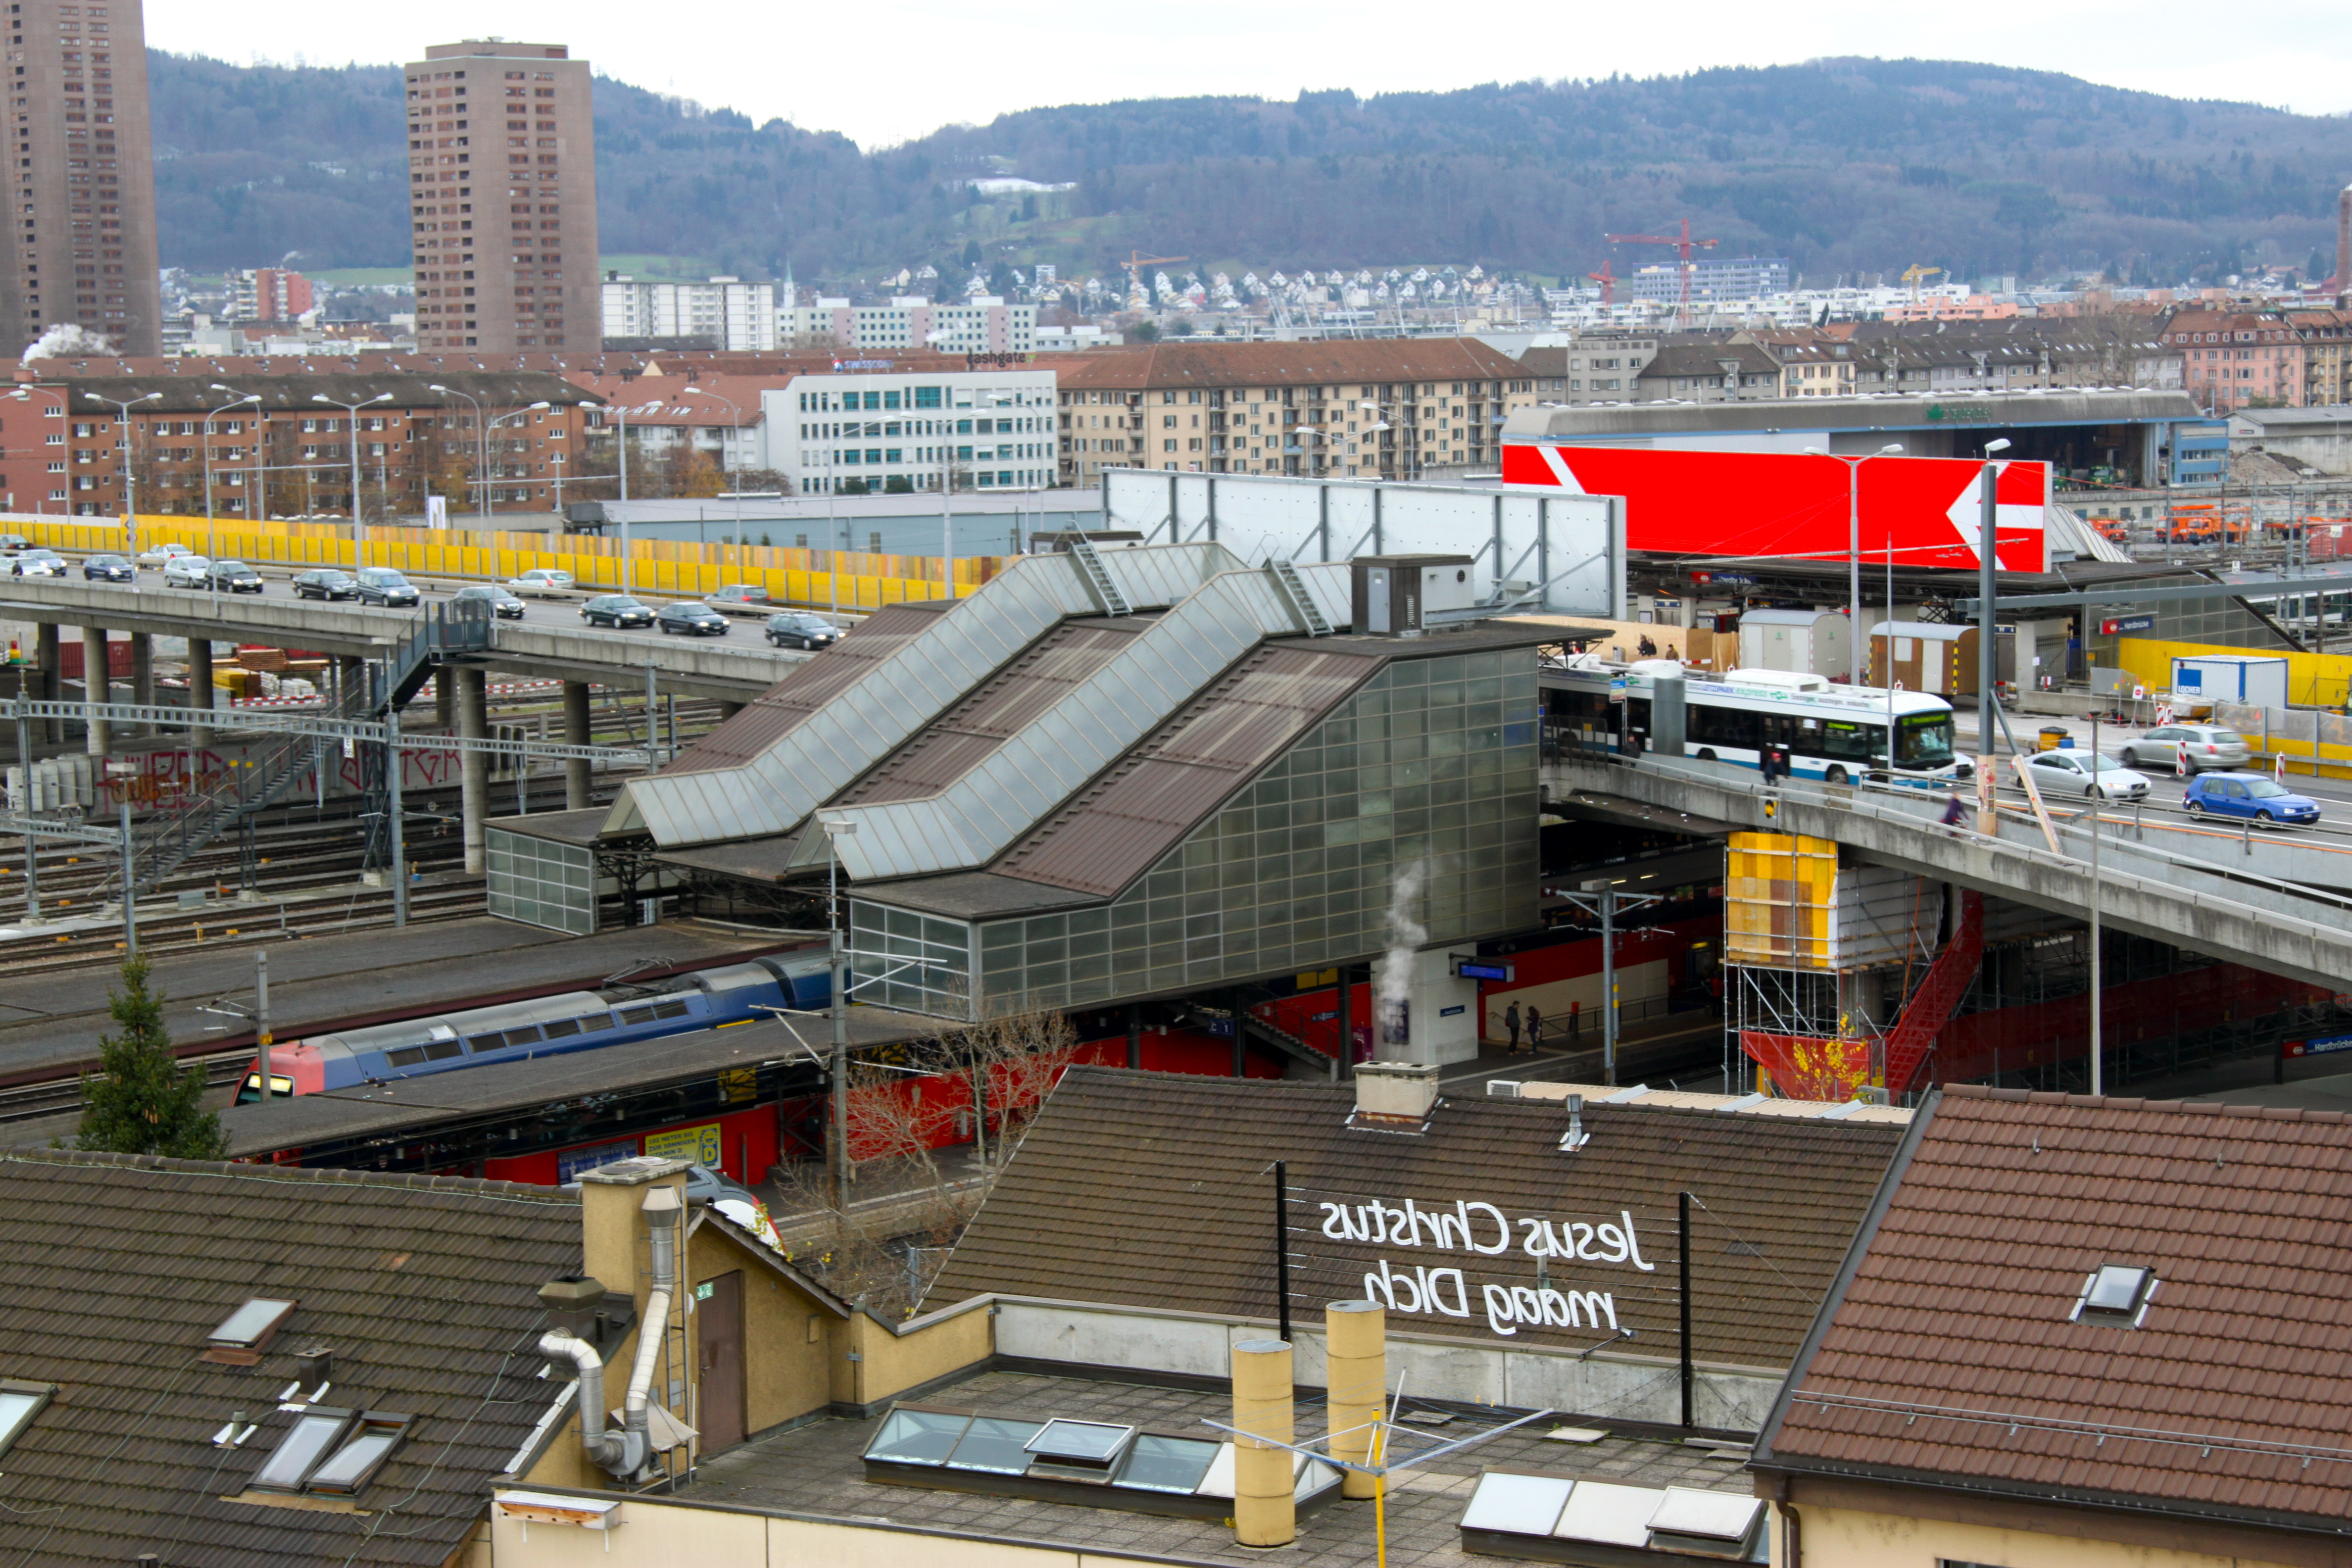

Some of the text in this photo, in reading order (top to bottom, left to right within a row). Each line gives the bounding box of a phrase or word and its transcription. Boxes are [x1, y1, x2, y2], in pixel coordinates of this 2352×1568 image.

[2178, 686, 2201, 694] LOCHER
[664, 1139, 696, 1148] SONNIGEN
[704, 1147, 716, 1162] D
